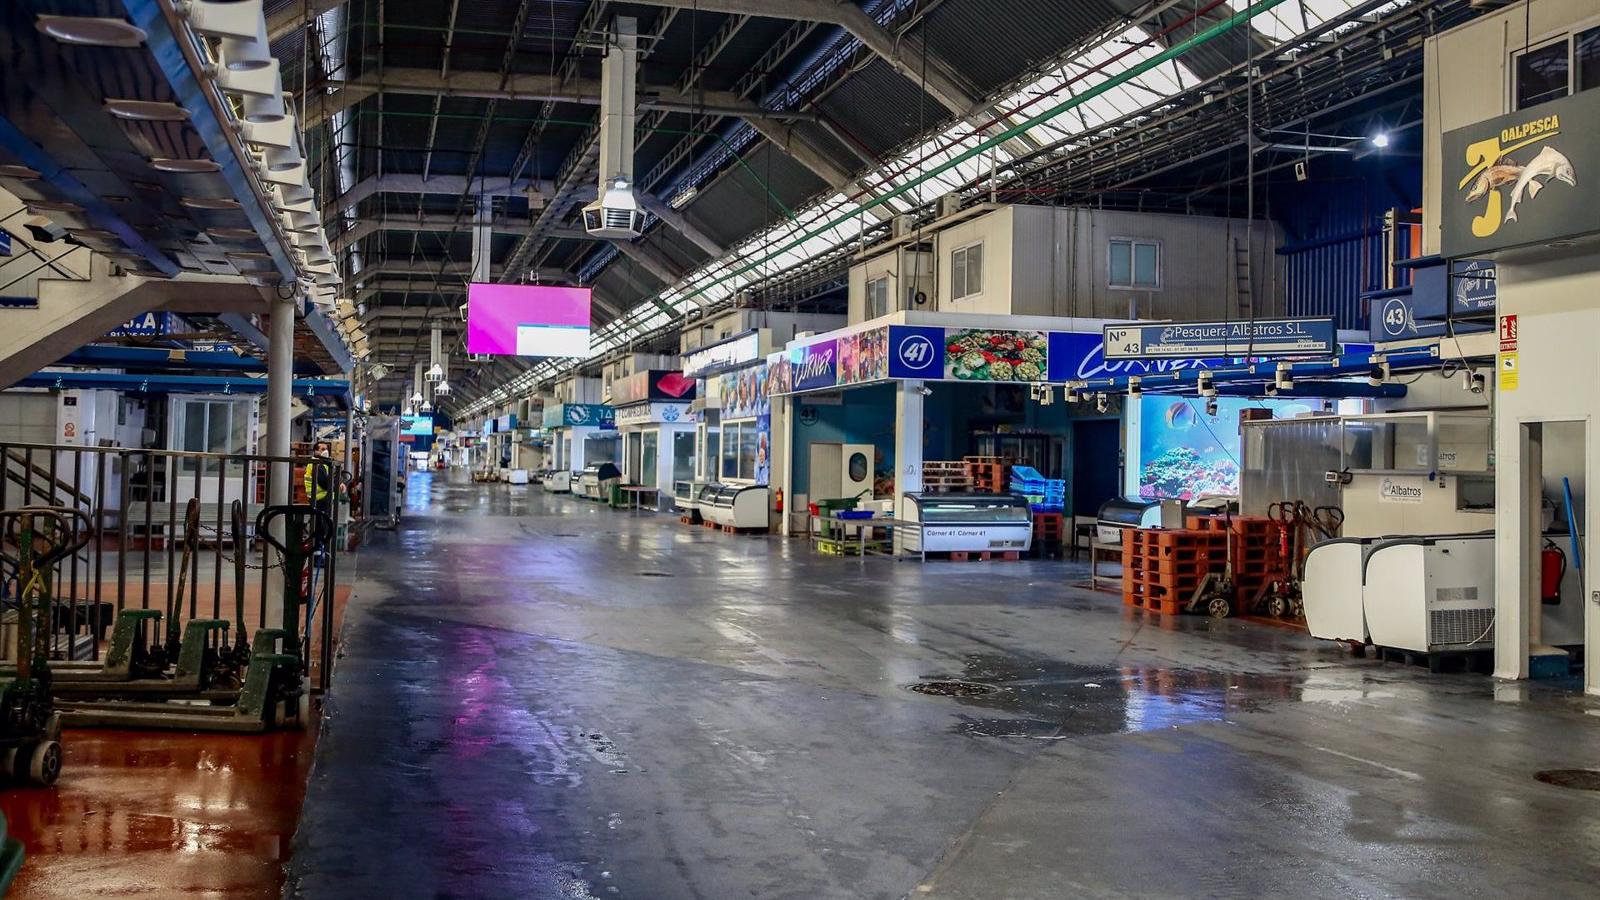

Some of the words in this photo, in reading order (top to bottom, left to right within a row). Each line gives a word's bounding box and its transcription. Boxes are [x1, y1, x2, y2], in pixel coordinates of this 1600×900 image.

[1385, 308, 1404, 326] 43
[1175, 326, 1229, 340] Pesquera
[1231, 324, 1282, 336] Albatros
[1286, 322, 1306, 334] S.L.
[903, 342, 929, 362] 41
[1123, 343, 1139, 353] 43
[1390, 485, 1422, 496] Albatros
